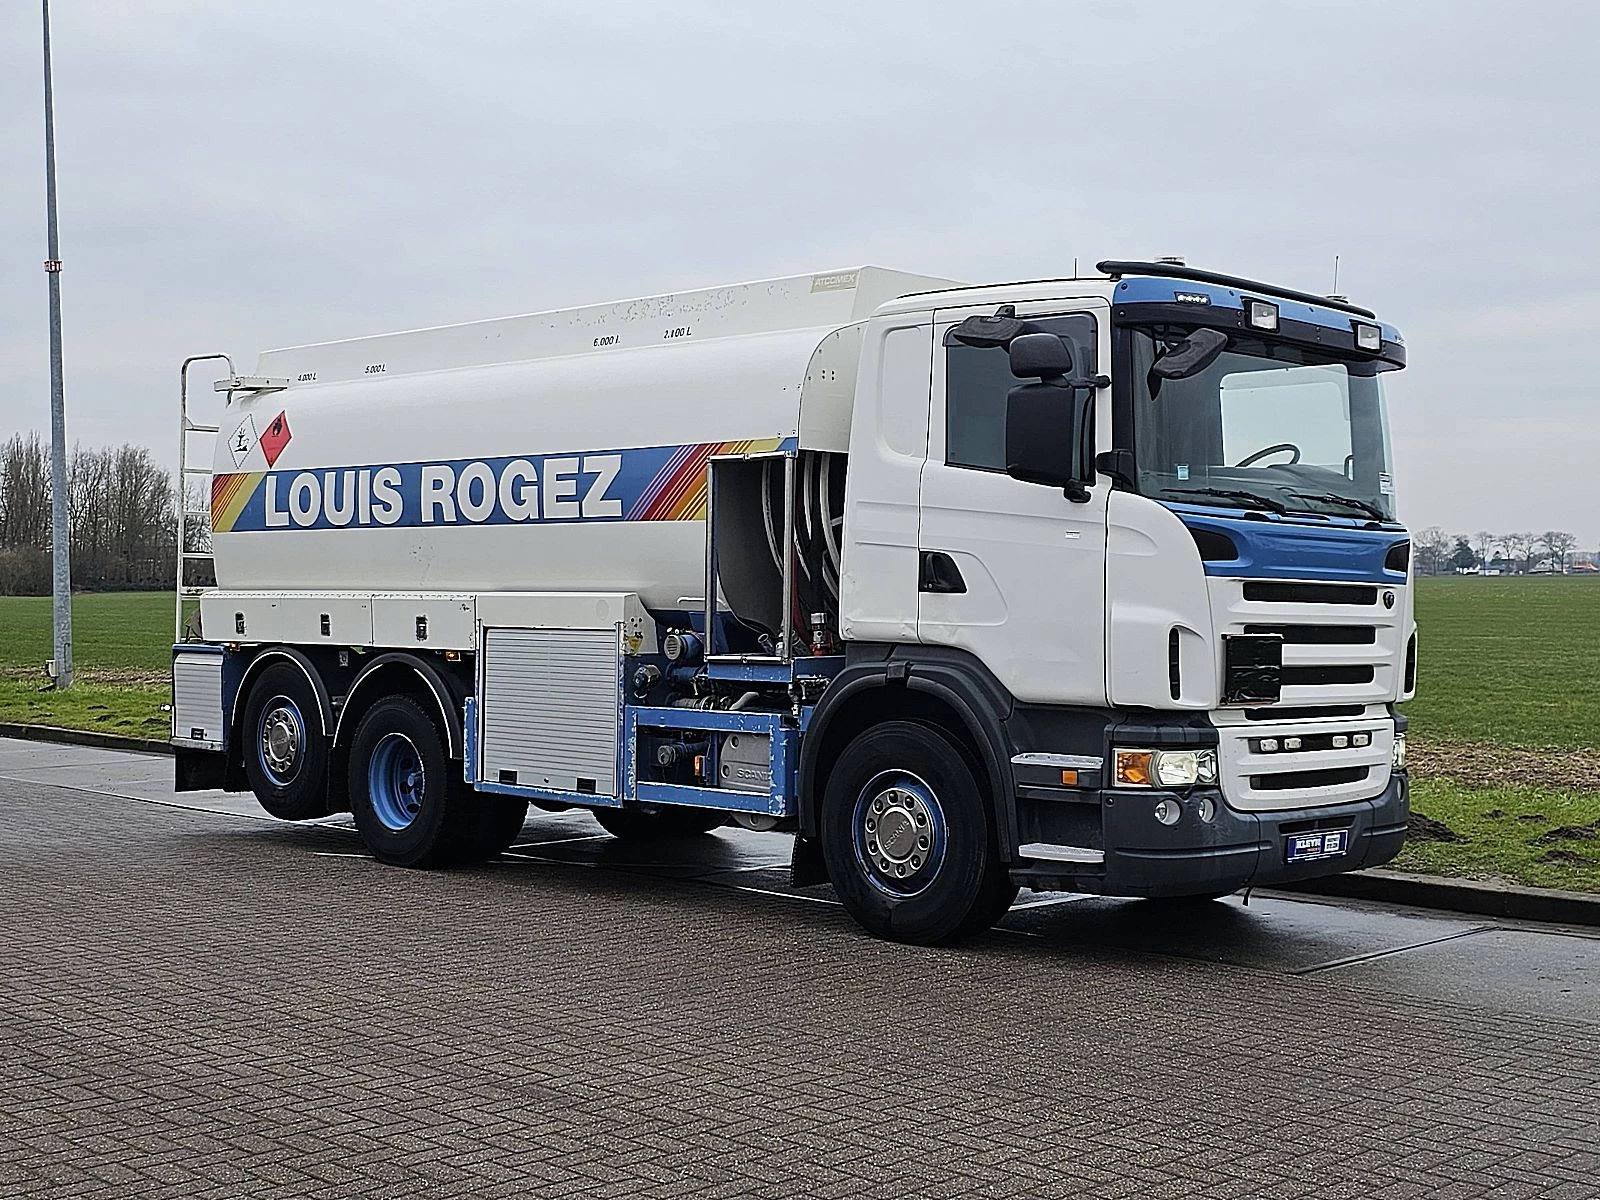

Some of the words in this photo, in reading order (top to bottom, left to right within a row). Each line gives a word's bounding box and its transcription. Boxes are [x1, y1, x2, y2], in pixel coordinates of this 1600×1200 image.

[815, 273, 856, 285] ATCOMEX
[664, 327, 685, 339] 2.100
[593, 335, 614, 347] 6.000
[264, 466, 404, 528] LOUIS
[420, 453, 623, 525] ROGEZ
